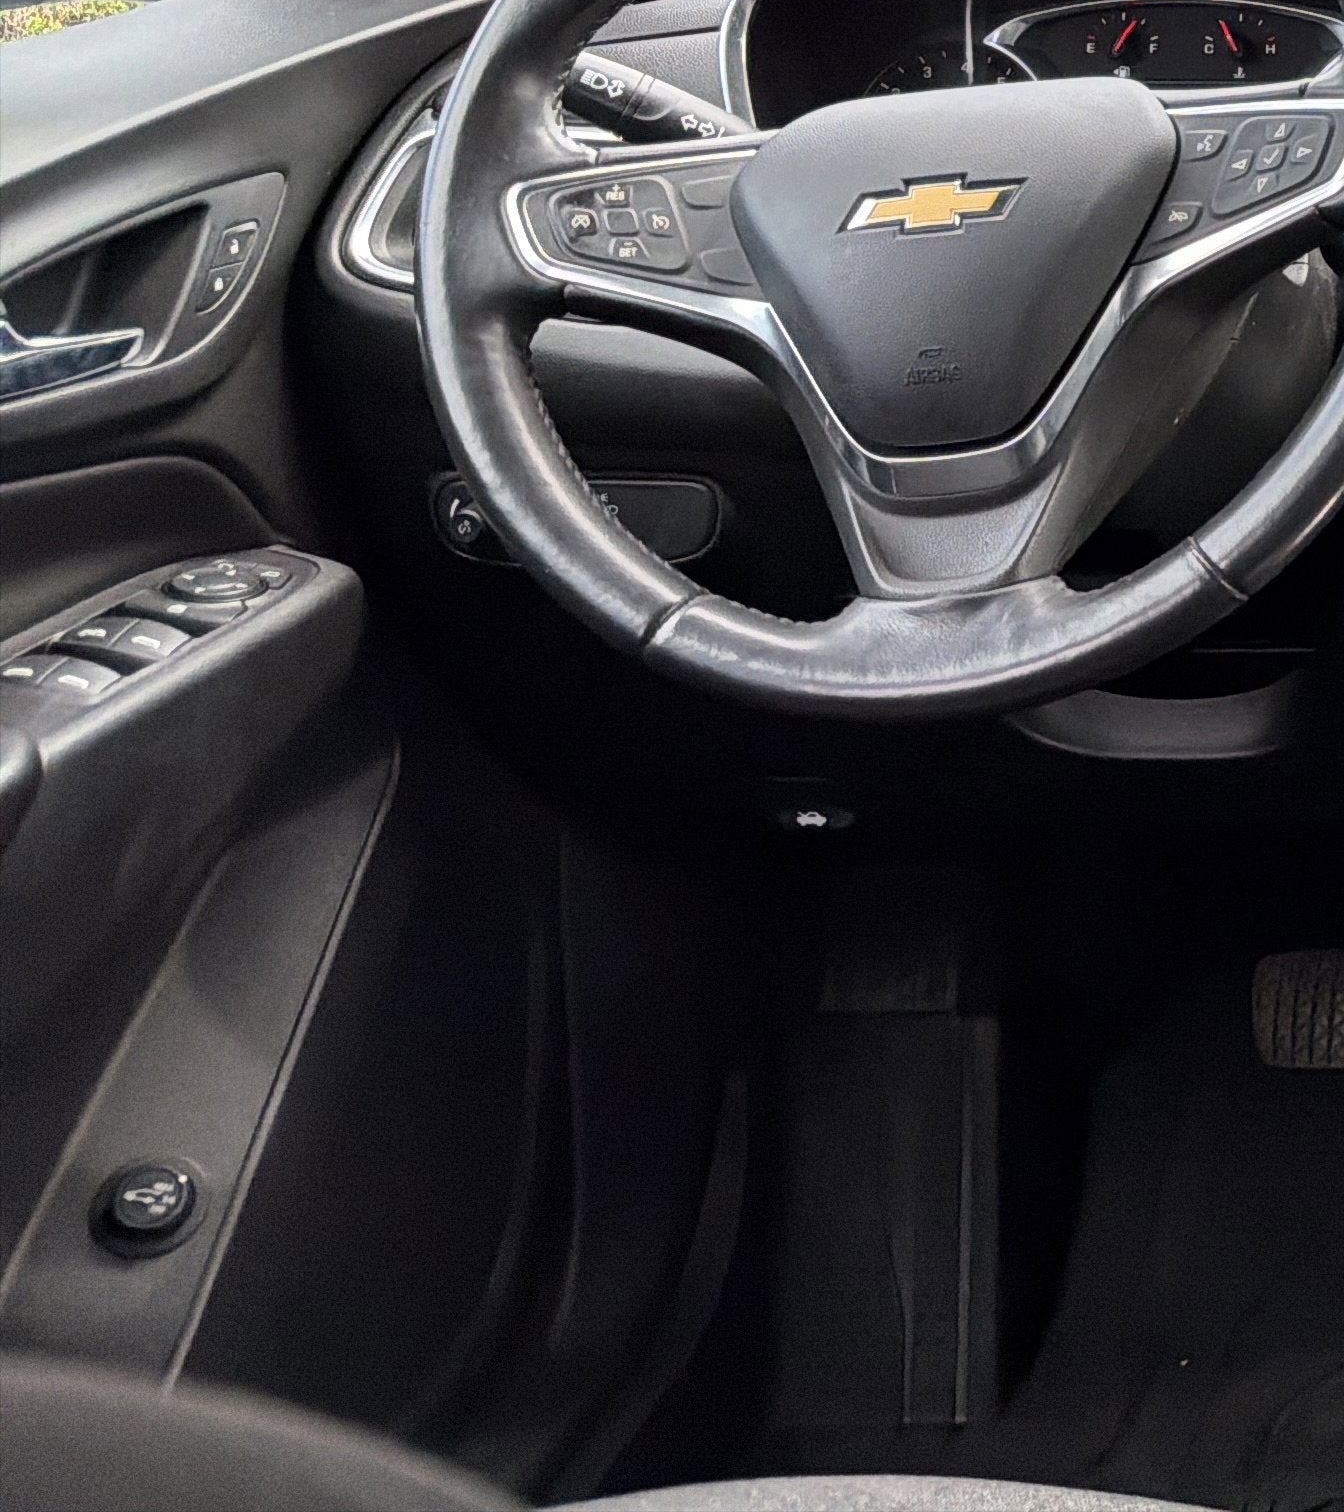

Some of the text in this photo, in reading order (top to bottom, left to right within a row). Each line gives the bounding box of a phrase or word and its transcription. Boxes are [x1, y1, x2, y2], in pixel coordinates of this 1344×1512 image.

[1086, 43, 1096, 54] E
[1150, 43, 1158, 53] F
[1204, 44, 1215, 54] C
[1265, 44, 1276, 54] H
[923, 66, 932, 78] 3
[619, 247, 638, 258] SET
